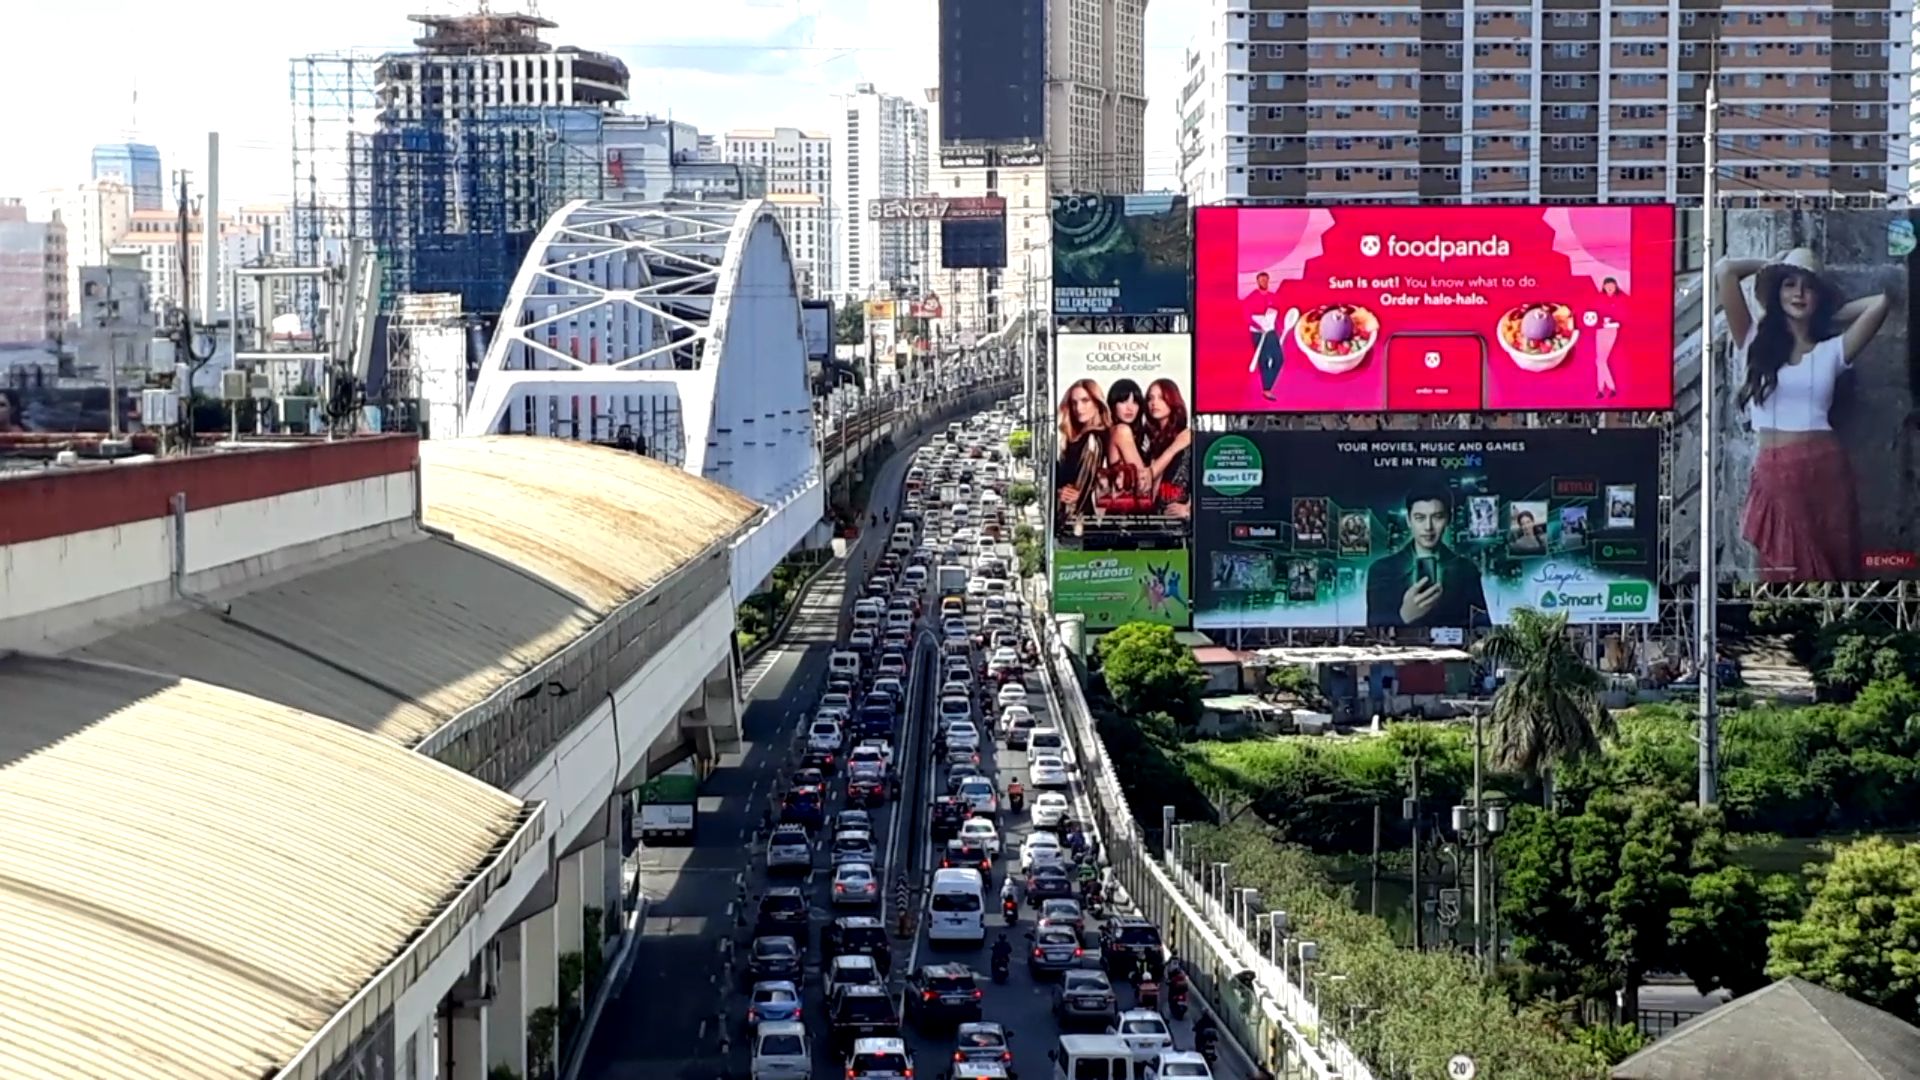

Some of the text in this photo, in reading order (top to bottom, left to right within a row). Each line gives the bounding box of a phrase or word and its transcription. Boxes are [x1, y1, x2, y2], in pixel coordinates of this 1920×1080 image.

[1388, 234, 1510, 262] foodpanda
[1328, 276, 1354, 289] Sun
[1357, 276, 1368, 289] is
[1371, 276, 1400, 289] out!
[1404, 276, 1427, 288] You
[1430, 276, 1464, 288] know
[1468, 276, 1498, 288] what
[1501, 277, 1516, 288] to
[1055, 287, 1120, 297] DRIVEN BEYOND
[1380, 292, 1488, 306] Order halo-halo.
[1098, 341, 1149, 351] REVLON
[1086, 351, 1161, 363] COLORSILK
[1337, 442, 1525, 453] YOUR MOVIES, MUSIC AND GAMES
[1374, 457, 1398, 467] LIVE
[1401, 457, 1413, 467] IN
[1416, 457, 1438, 467] THE
[1088, 558, 1119, 569] COVID
[1058, 567, 1134, 581] SUPER HEROES!
[1559, 591, 1644, 606] Smart ako
